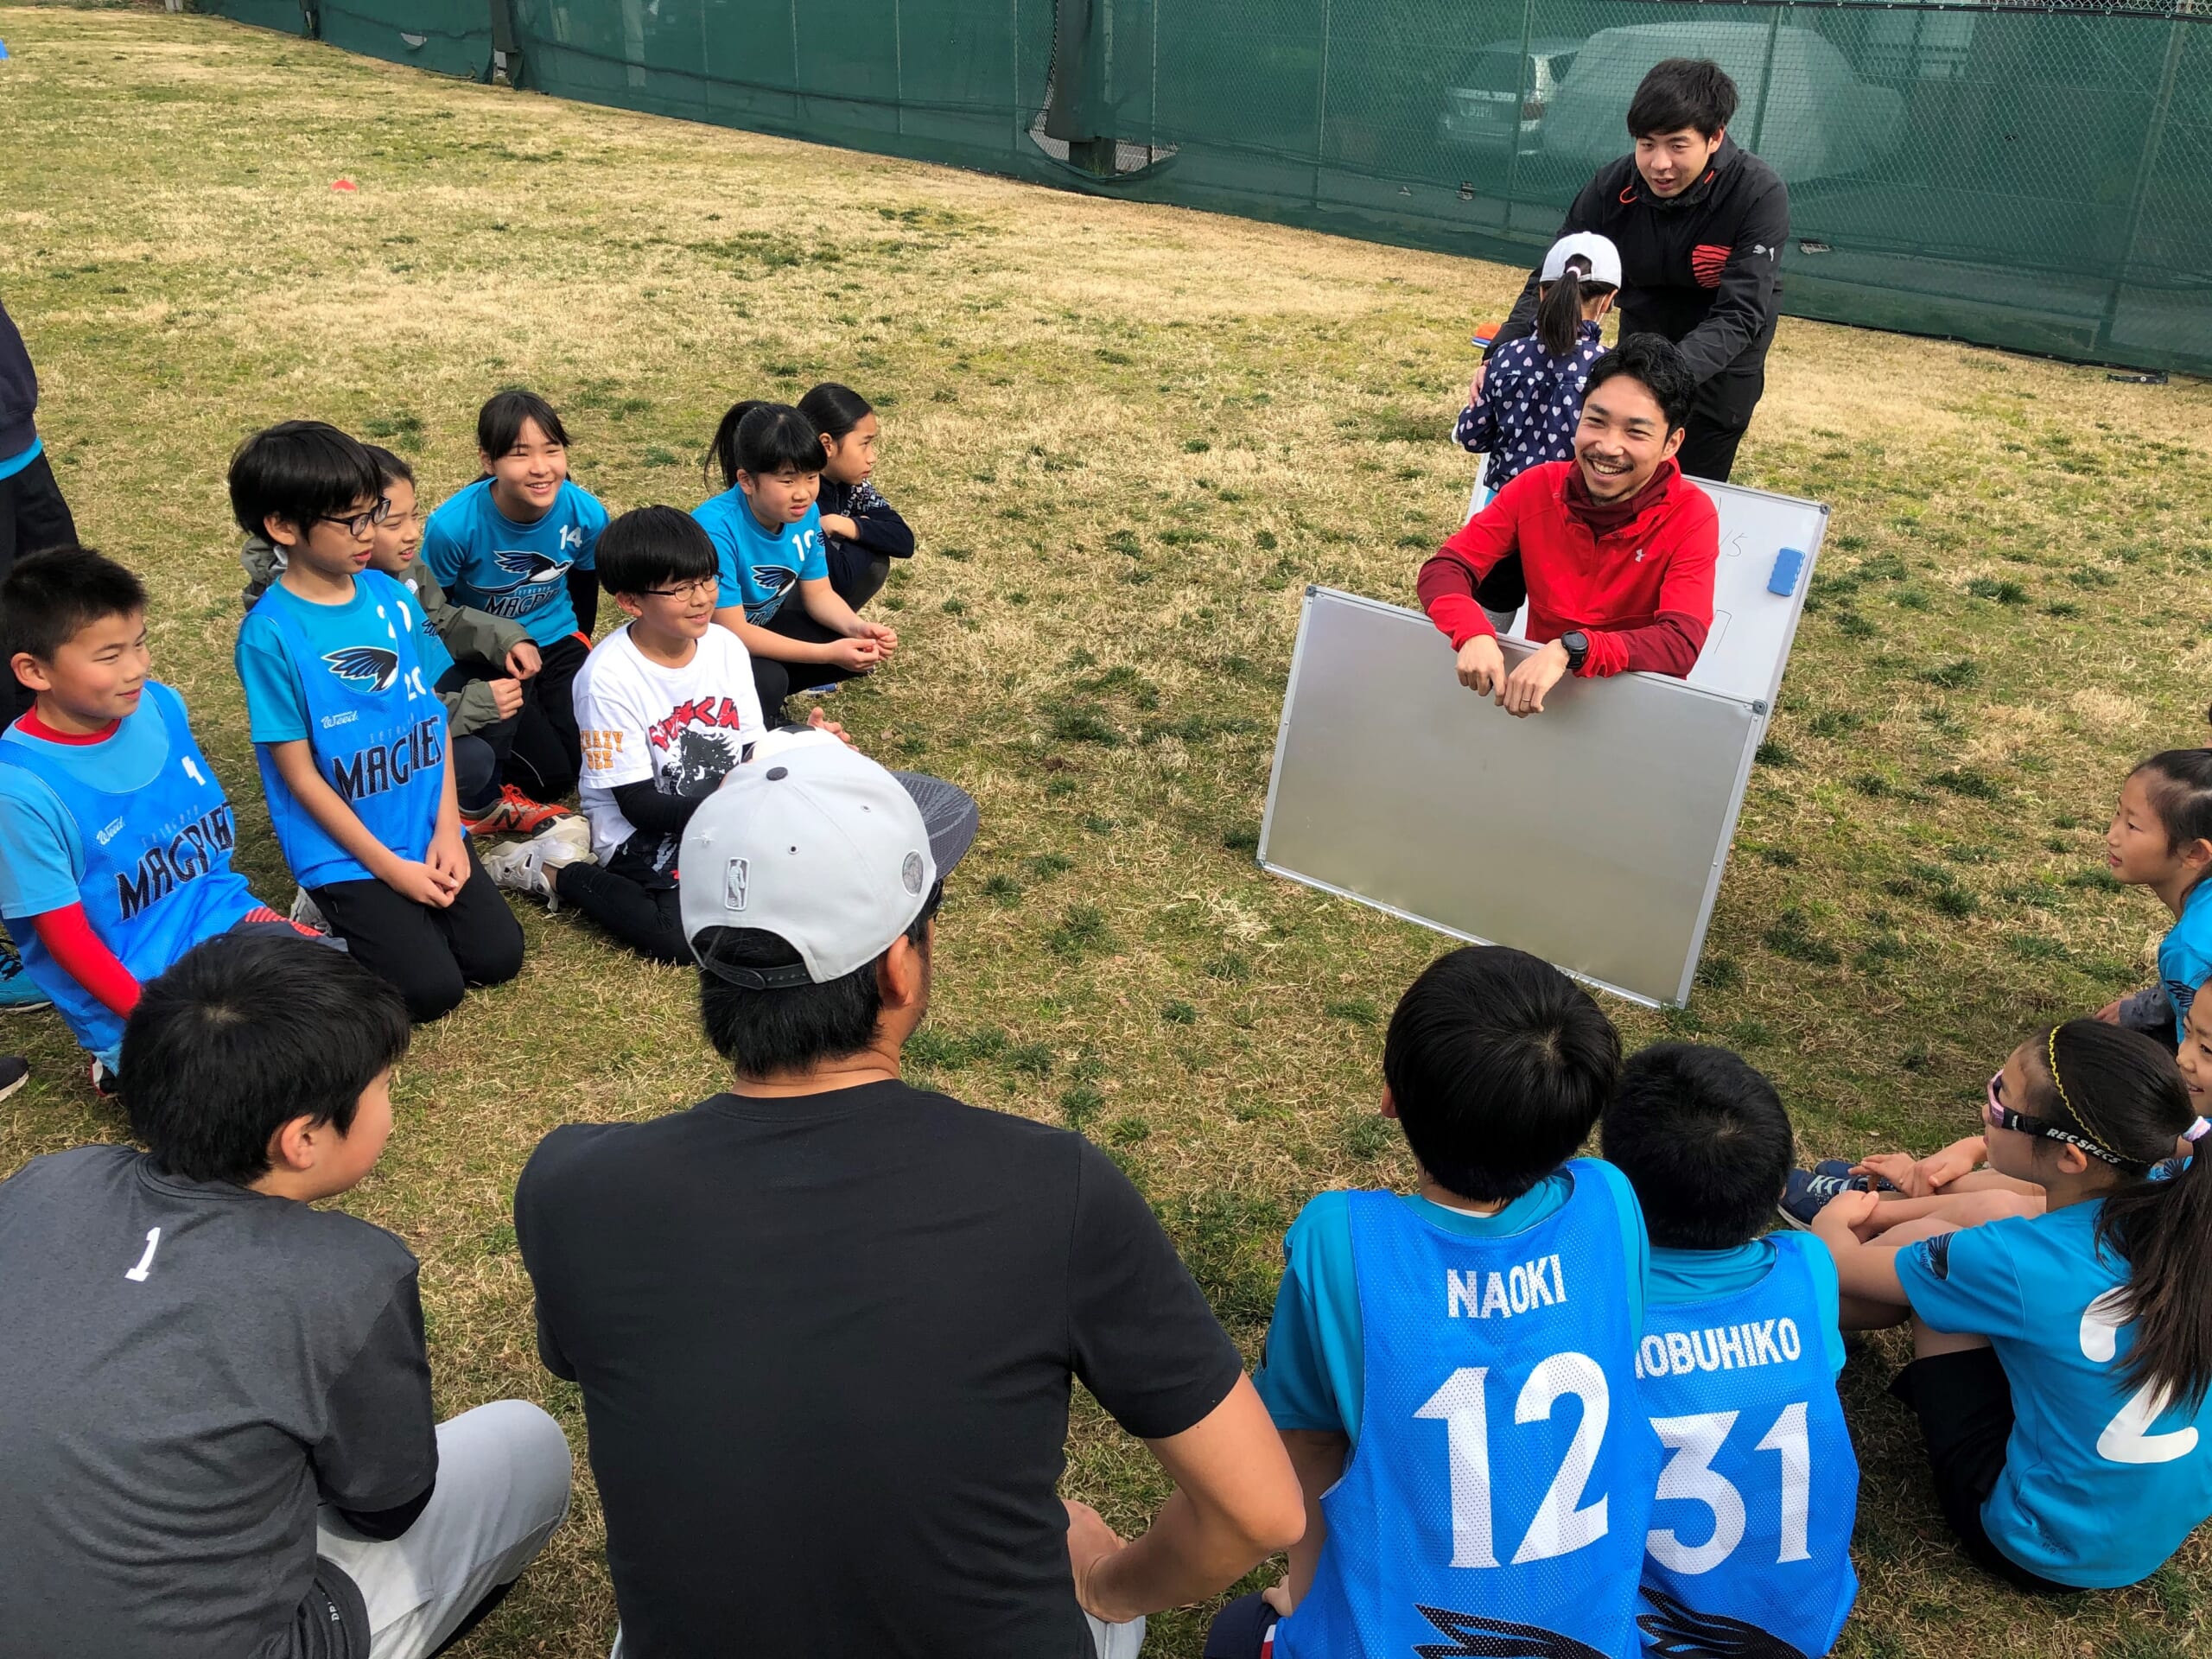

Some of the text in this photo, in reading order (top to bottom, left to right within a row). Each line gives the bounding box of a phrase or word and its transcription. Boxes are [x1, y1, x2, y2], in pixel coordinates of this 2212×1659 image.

[559, 524, 582, 550] 14
[332, 715, 442, 802] MAGIES
[116, 801, 232, 922] MAGPIE
[124, 1227, 161, 1281] 1
[1446, 1254, 1567, 1319] NAOKI
[1412, 1351, 1610, 1568] 12
[1645, 1402, 1812, 1575] 31
